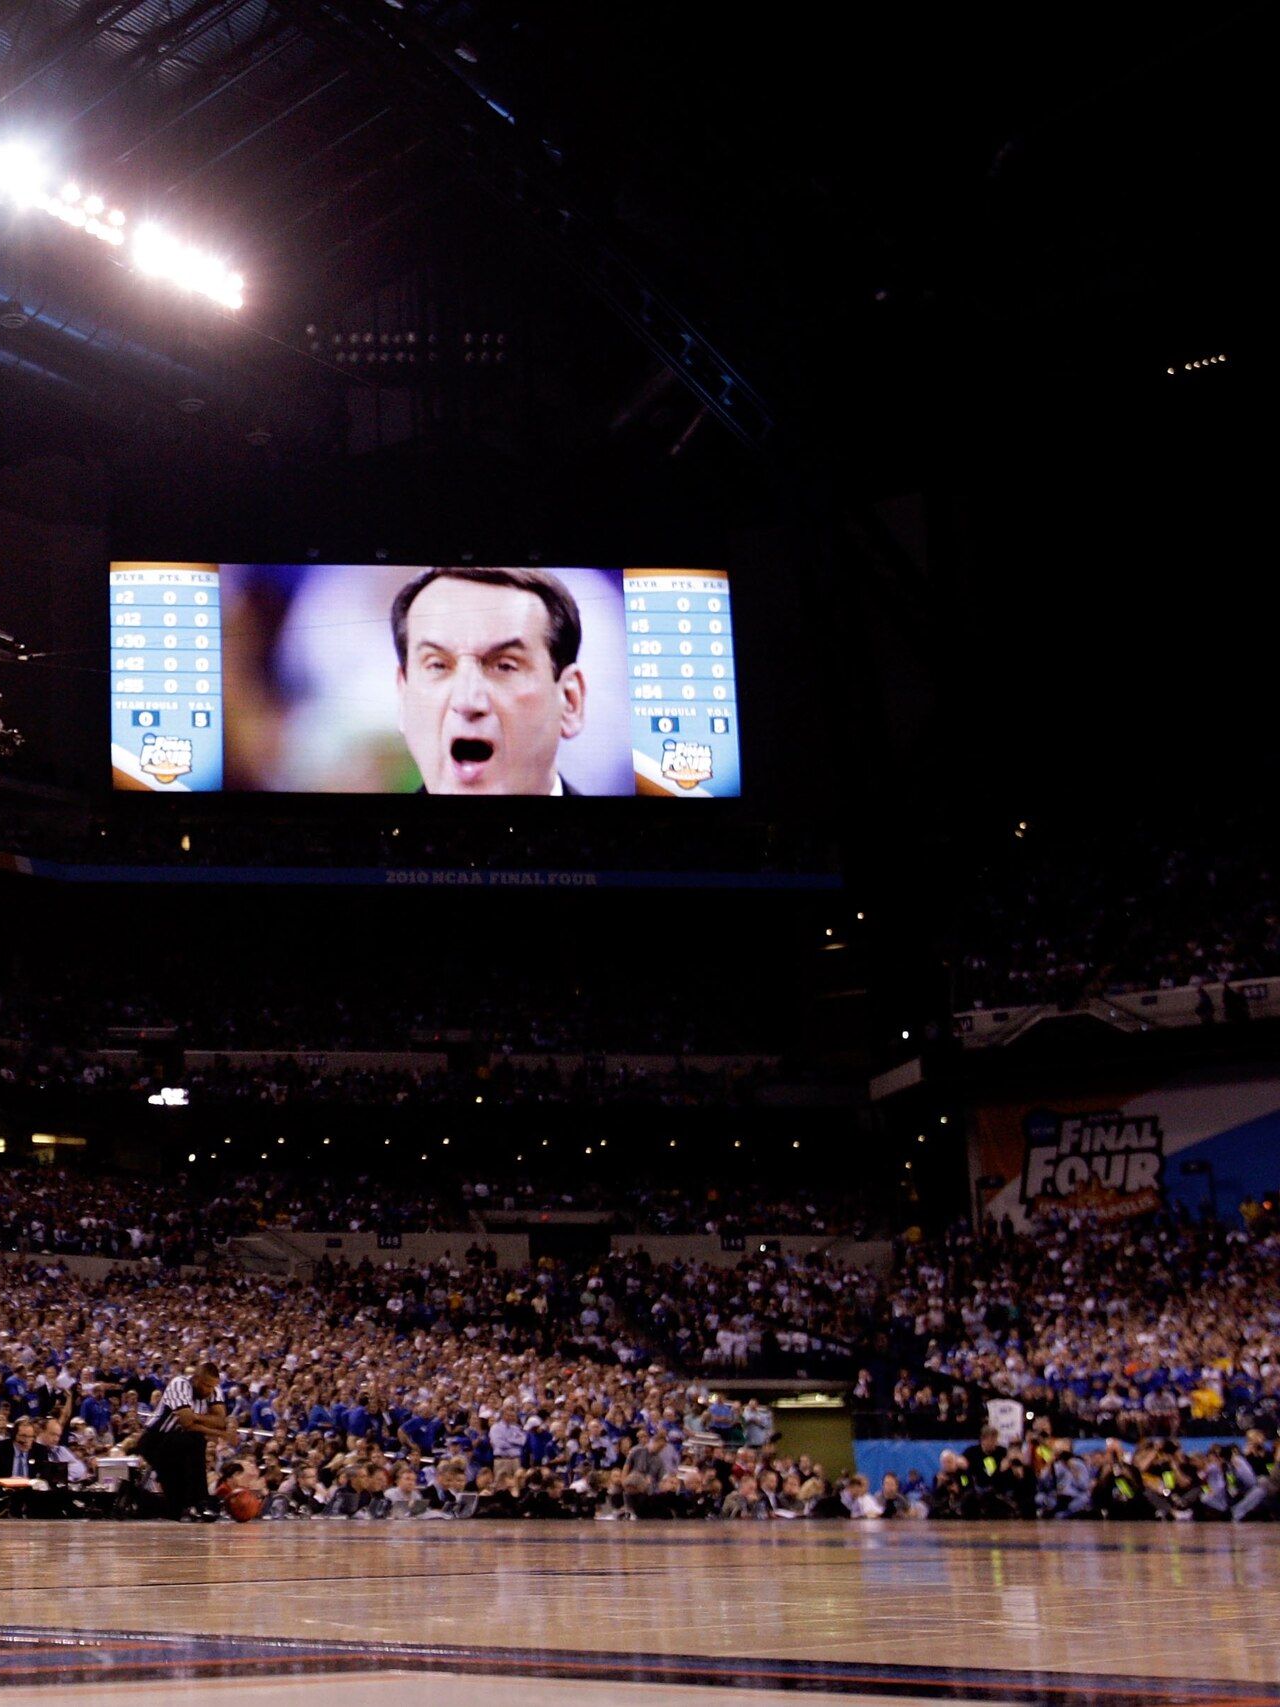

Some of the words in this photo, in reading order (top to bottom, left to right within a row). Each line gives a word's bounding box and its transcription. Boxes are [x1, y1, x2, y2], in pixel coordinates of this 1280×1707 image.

[163, 591, 177, 606] 0
[194, 591, 208, 606] 0
[676, 597, 690, 612] 0
[707, 598, 721, 613] 0
[163, 612, 177, 627] 0
[194, 613, 209, 628] 0
[678, 619, 691, 634] 0
[709, 619, 722, 634] 0
[163, 634, 177, 649] 0
[195, 635, 209, 650] 0
[679, 641, 693, 656] 0
[710, 641, 724, 656] 0
[163, 657, 178, 672] 0
[195, 657, 209, 672] 0
[681, 663, 694, 678] 0
[712, 664, 725, 679] 0
[164, 679, 178, 694] 0
[196, 679, 210, 694] 0
[682, 685, 695, 700] 0
[713, 685, 726, 700] 0
[138, 711, 154, 727] 0
[658, 717, 673, 734] 0
[385, 871, 428, 884] 2010
[432, 871, 483, 884] NCAA
[489, 872, 544, 885] FINAL
[546, 872, 597, 885] FOUR
[1060, 1119, 1158, 1155] FINAL
[1025, 1145, 1160, 1199] FOUR
